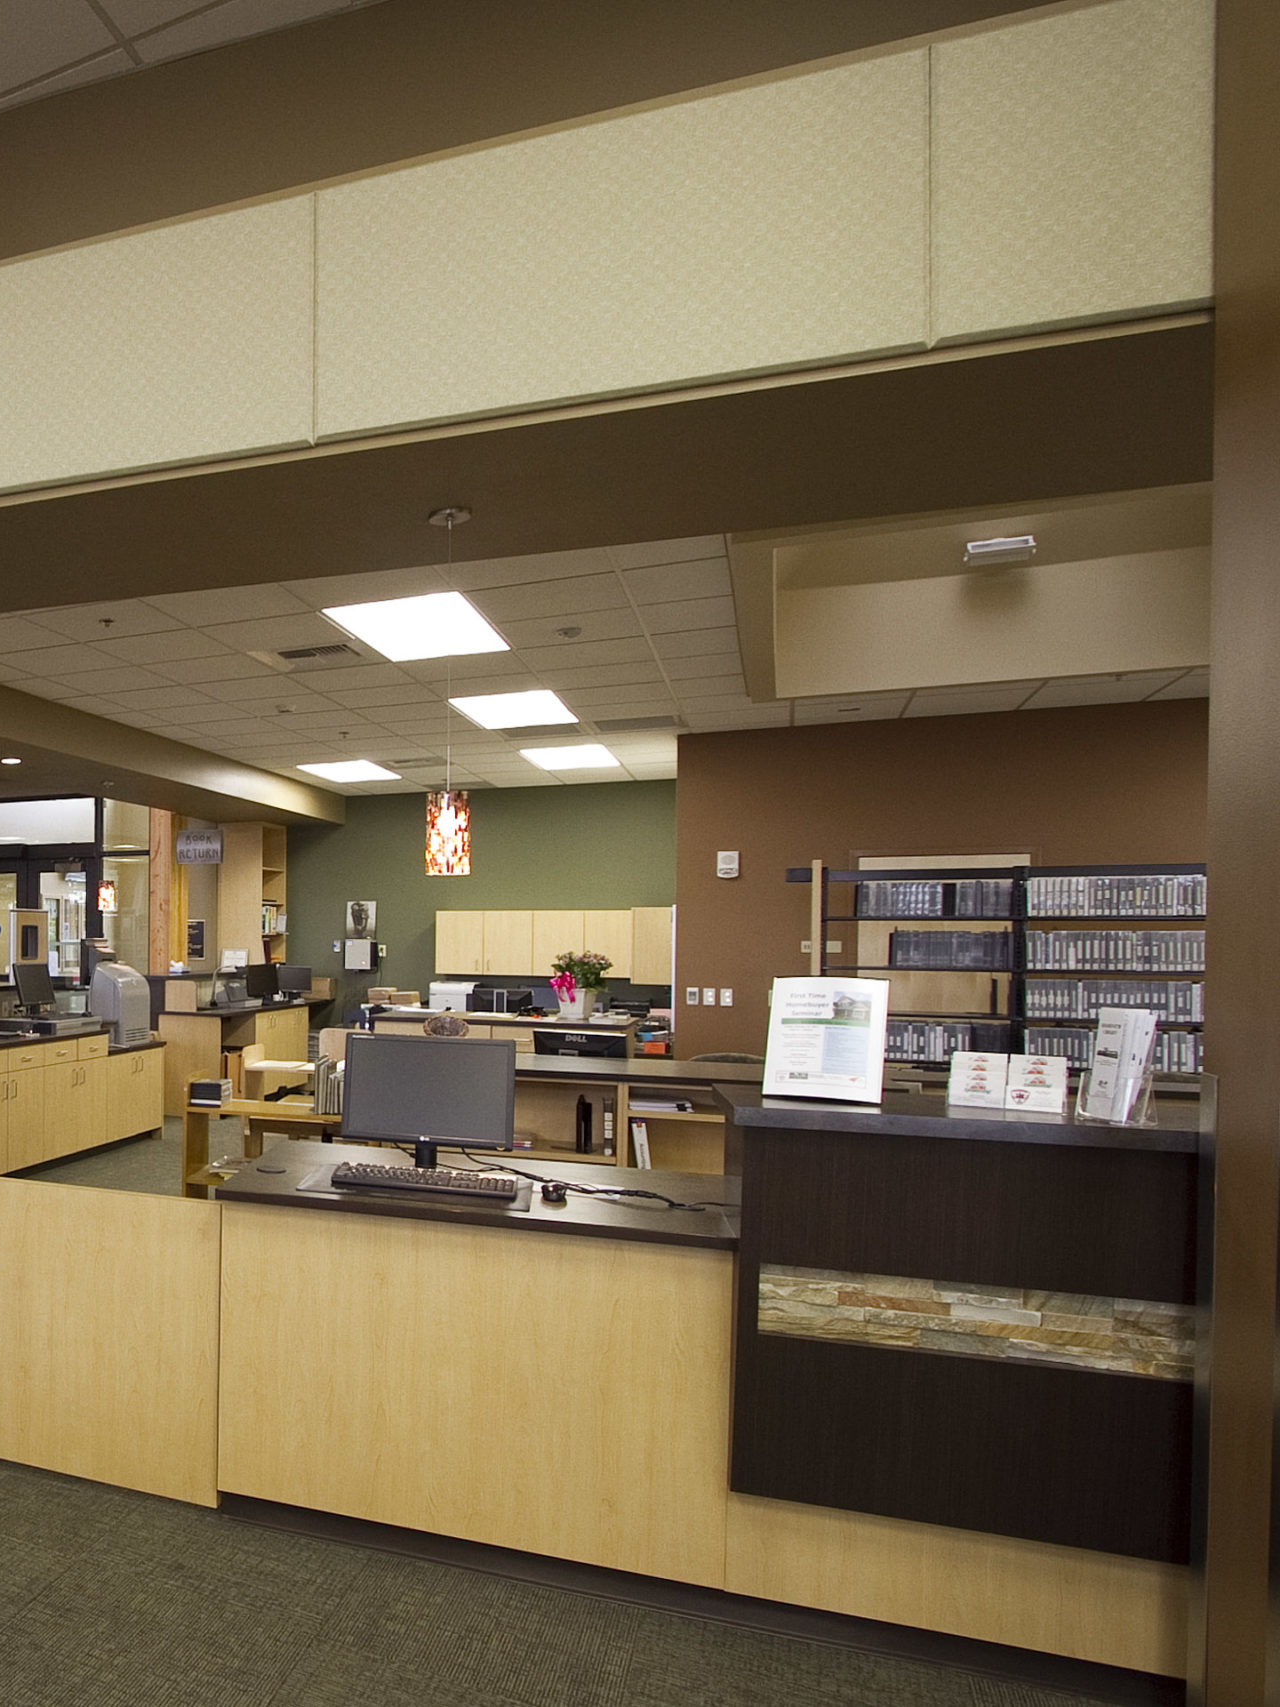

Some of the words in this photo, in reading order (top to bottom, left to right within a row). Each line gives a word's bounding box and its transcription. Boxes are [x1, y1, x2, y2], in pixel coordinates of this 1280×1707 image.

[185, 834, 212, 845] BOOK
[179, 848, 219, 859] RETURN
[565, 1034, 587, 1042] DELL
